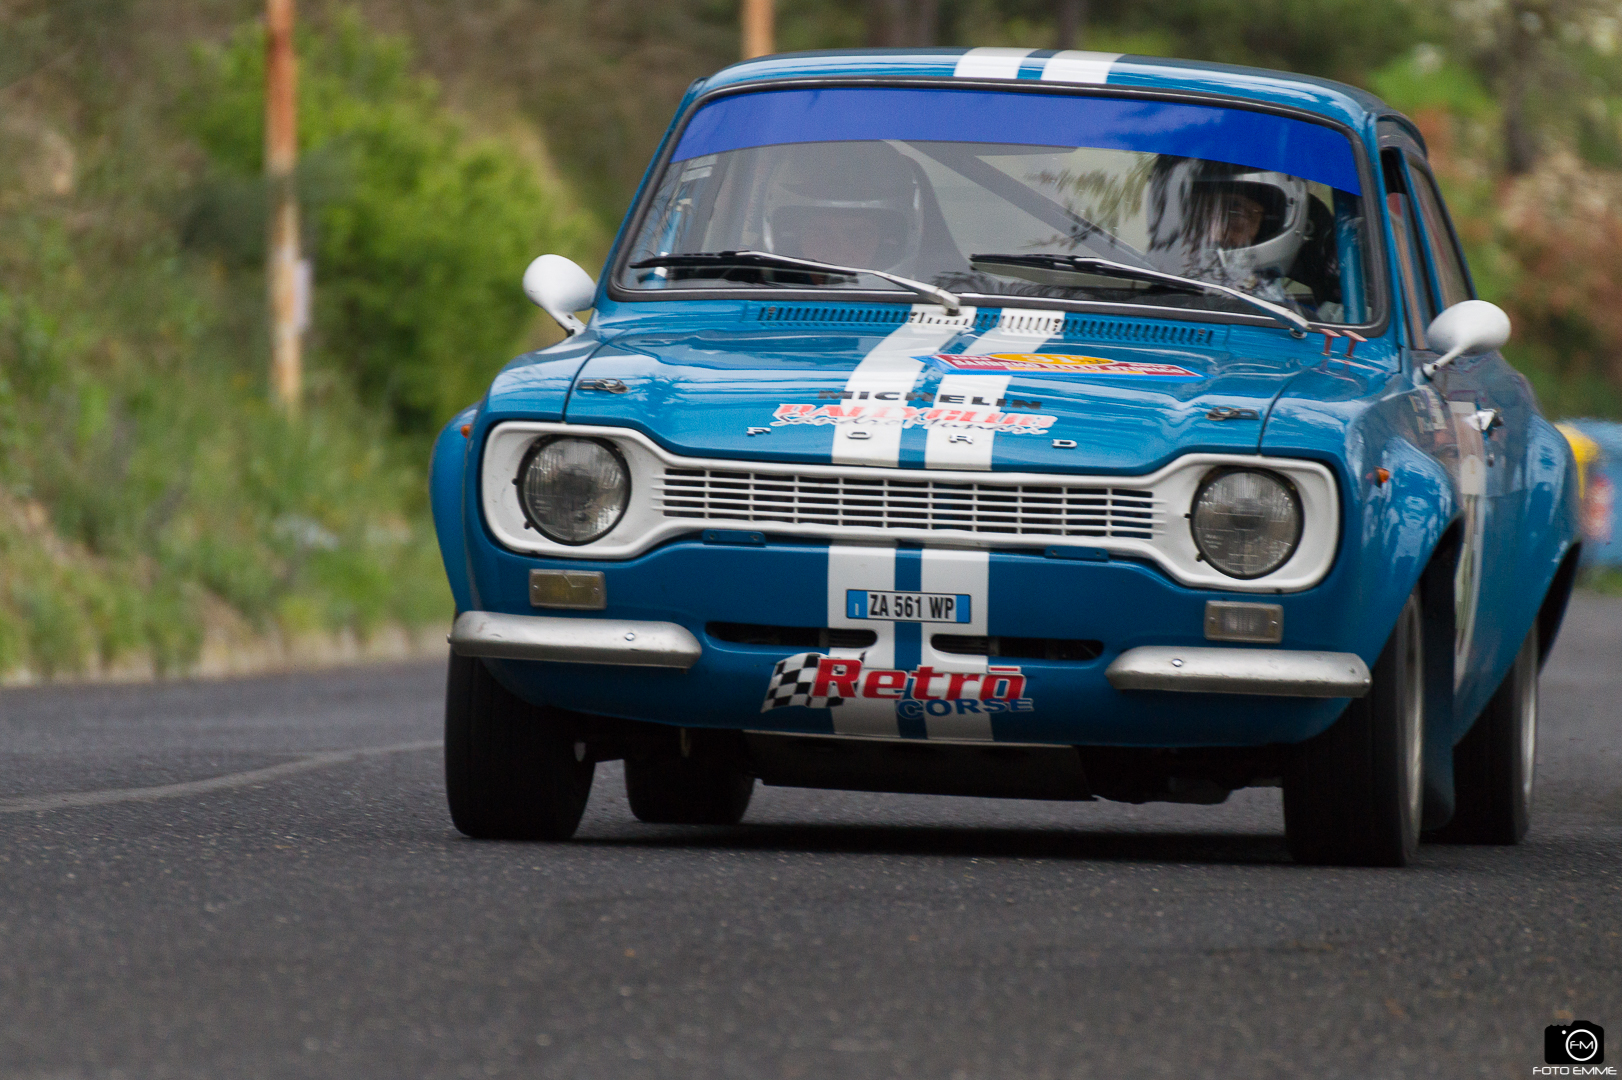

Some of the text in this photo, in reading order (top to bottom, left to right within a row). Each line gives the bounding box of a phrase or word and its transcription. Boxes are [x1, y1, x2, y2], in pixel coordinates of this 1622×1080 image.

[818, 391, 1041, 409] MICHELIN
[747, 427, 1077, 448] FORD
[870, 594, 889, 617] ZA
[894, 596, 922, 618] 561
[929, 597, 954, 619] WP
[899, 698, 1034, 719] CORSE
